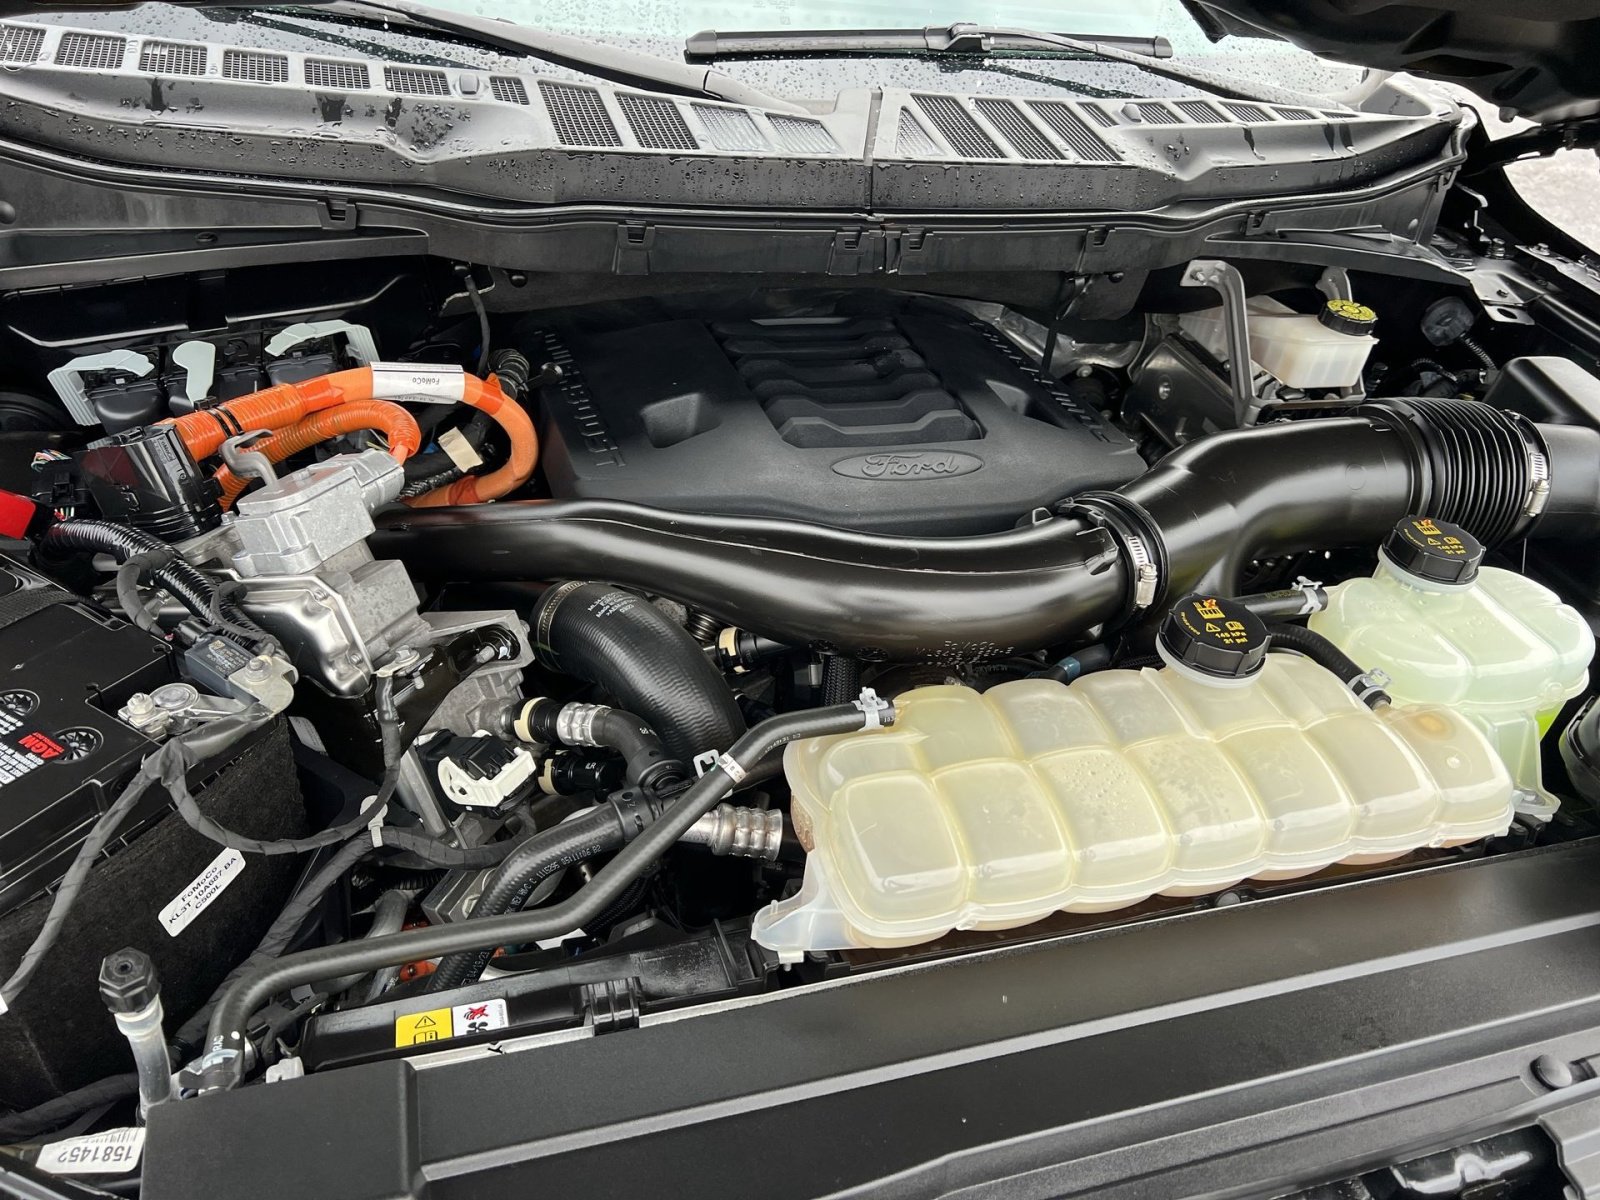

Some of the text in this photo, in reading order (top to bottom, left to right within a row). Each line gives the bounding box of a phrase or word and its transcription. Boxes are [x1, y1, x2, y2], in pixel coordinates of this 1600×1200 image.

[412, 377, 440, 385] FoMoCo
[861, 453, 960, 477] Ford
[18, 735, 60, 759] AGM
[169, 857, 237, 924] KL3T 10A687 BA
[181, 867, 218, 902] FoMoCo
[195, 885, 222, 909] C500L
